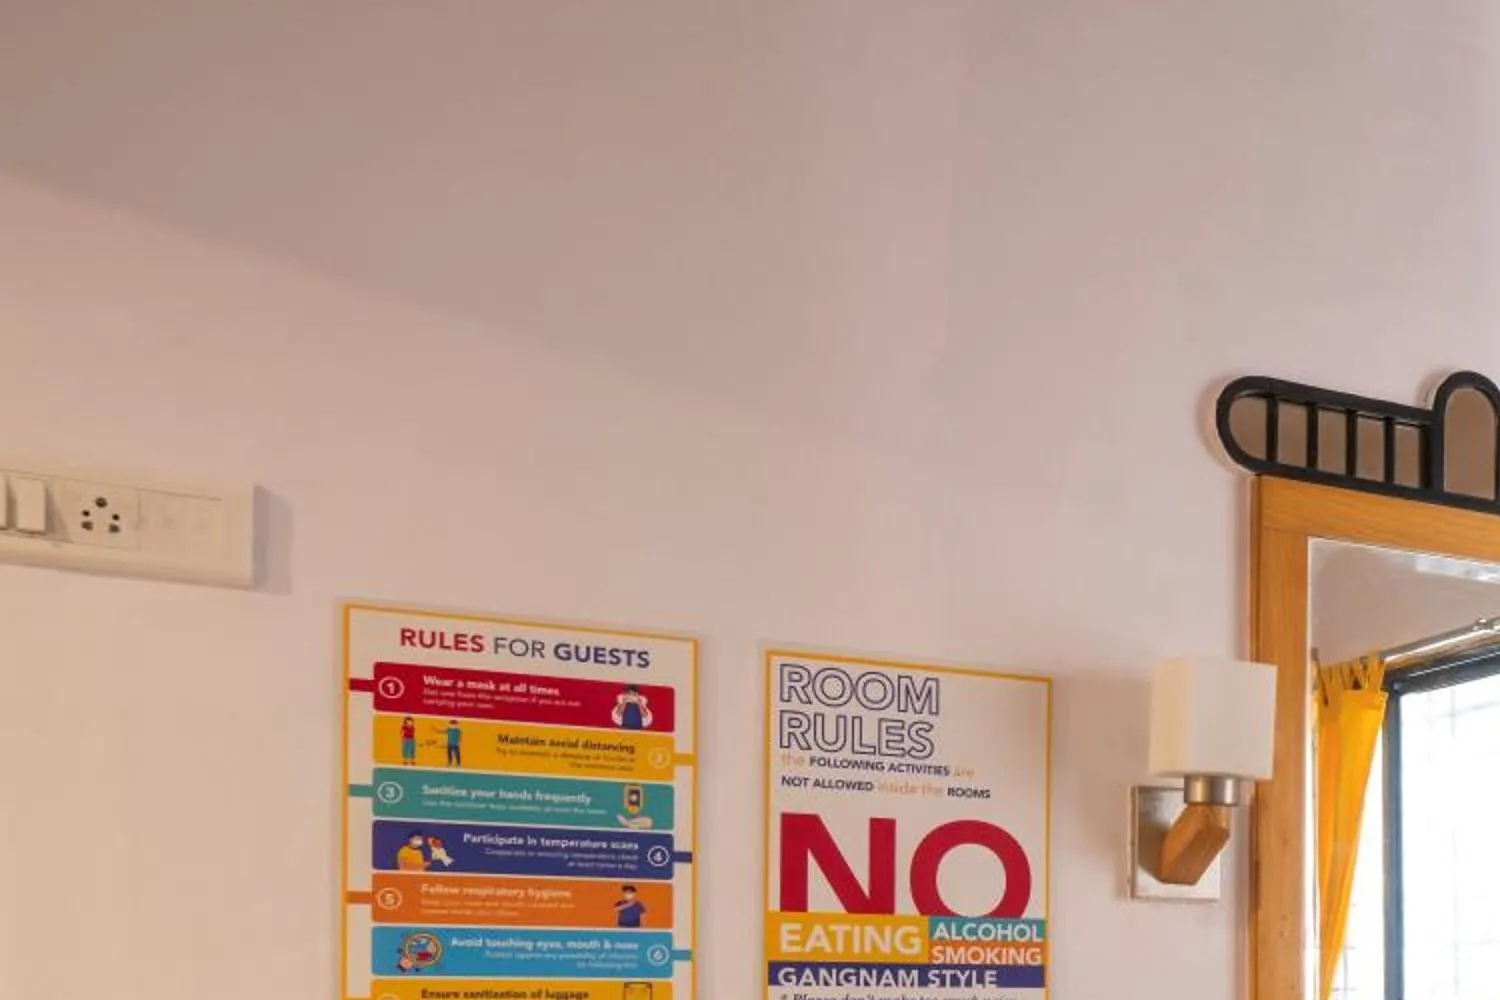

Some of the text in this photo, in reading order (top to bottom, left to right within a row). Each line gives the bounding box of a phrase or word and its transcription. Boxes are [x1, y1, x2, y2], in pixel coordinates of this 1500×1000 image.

[399, 627, 651, 669] RULES FOR GUESTS
[456, 680, 464, 688] a
[498, 682, 511, 692] at
[513, 682, 527, 693] all
[779, 663, 940, 716] ROOM
[498, 734, 545, 746] Maintain
[779, 709, 935, 760] RULES
[809, 756, 885, 772] FOLLOWING
[887, 762, 950, 777] ACTIVITIES
[781, 775, 809, 788] NOT
[812, 777, 874, 793] ALLOWED
[947, 787, 991, 799] ROOMS
[469, 788, 496, 799] your
[498, 789, 533, 801] hands
[534, 791, 592, 806] frequently
[463, 833, 525, 847] Participate
[527, 836, 537, 846] in
[540, 837, 607, 849] temperature
[779, 812, 1032, 919] NO
[421, 883, 572, 900] Follow respiratory hygiene
[779, 923, 922, 955] EATING
[932, 923, 1043, 942] ALCOHOL
[451, 938, 483, 948] Avoid
[486, 939, 533, 950] touching
[931, 947, 1042, 966] SMOKING
[778, 967, 997, 988] GANGNAM STYLE
[421, 988, 460, 999] Ensure
[530, 988, 542, 999] of
